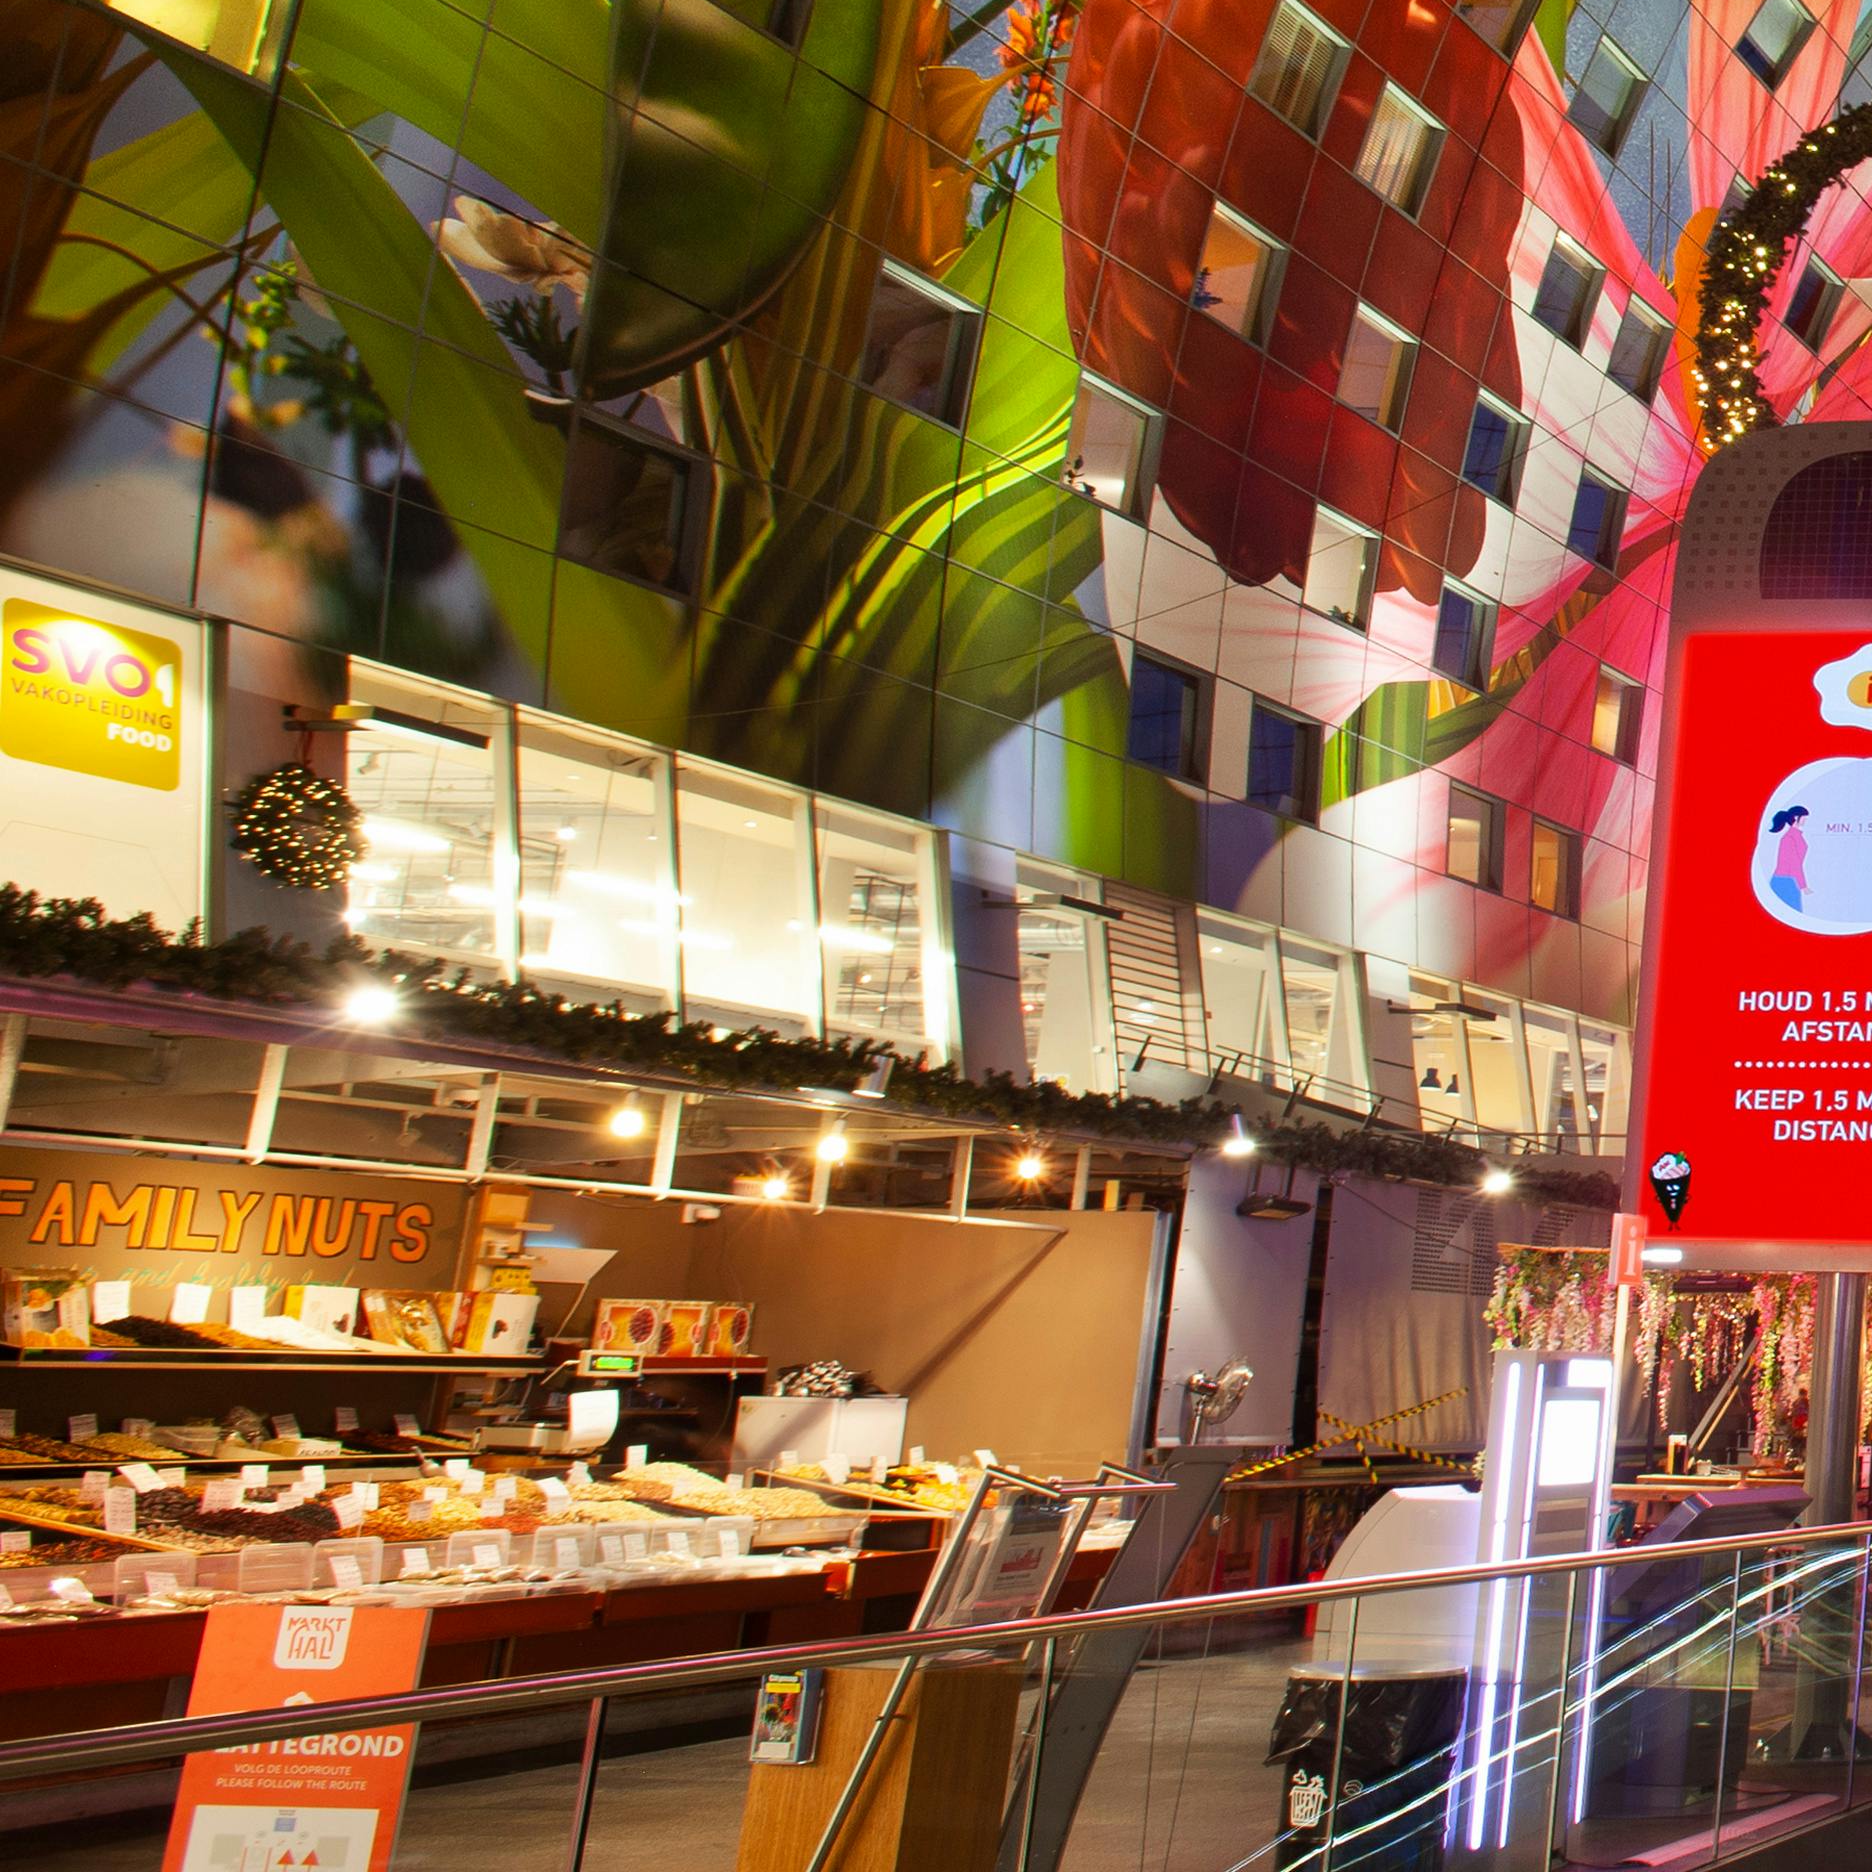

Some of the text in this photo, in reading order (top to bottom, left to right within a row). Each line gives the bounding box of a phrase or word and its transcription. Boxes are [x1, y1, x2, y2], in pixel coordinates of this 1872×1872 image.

[11, 628, 152, 698] SVO
[11, 677, 173, 730] VAKOPLEIDING
[106, 722, 173, 752] FOOD
[1826, 823, 1853, 833] MIN.
[1738, 991, 1813, 1012] HOUD
[1734, 1089, 1805, 1110] KEEP
[0, 1175, 434, 1263] FAMILY NUTS
[287, 1617, 347, 1632] MARKT
[287, 1634, 335, 1660] HAL
[234, 1763, 352, 1776] VOLG DE LOOPROUTE
[216, 1777, 368, 1792] PLEASE FOLLOW THE ROUTE
